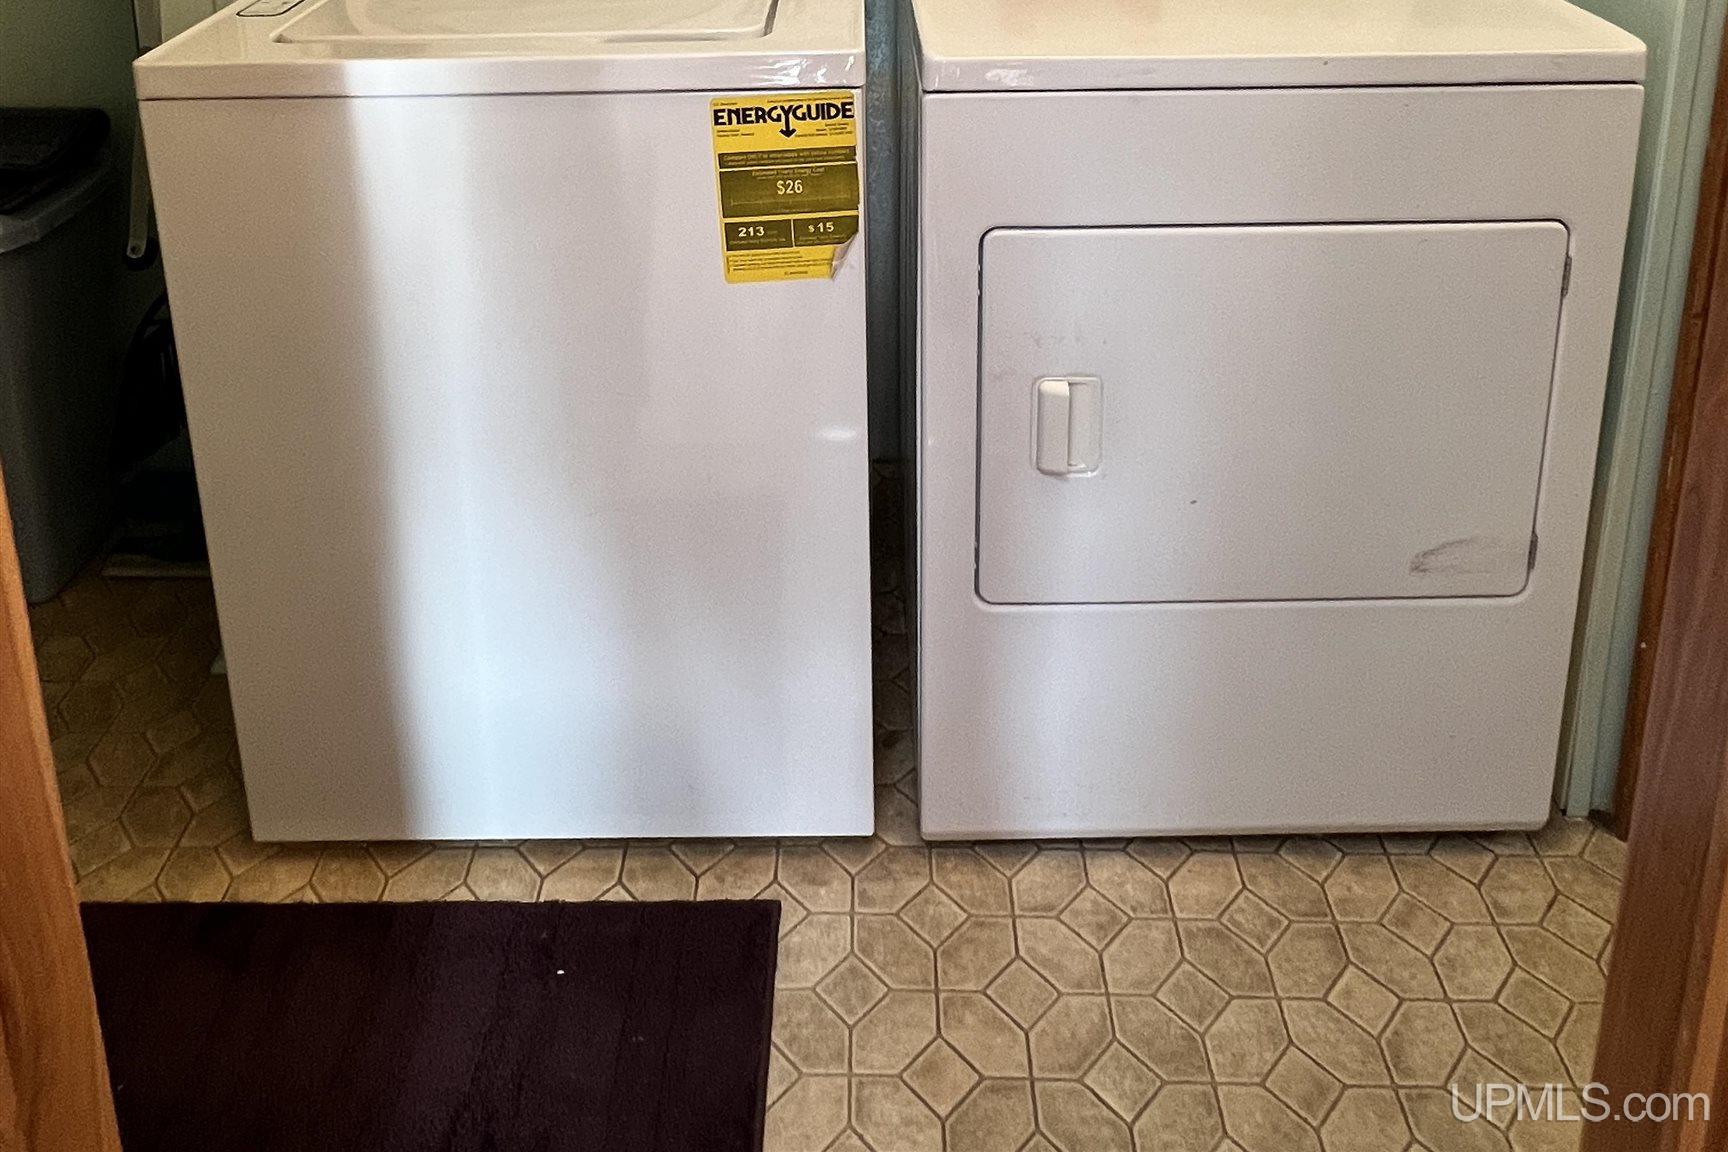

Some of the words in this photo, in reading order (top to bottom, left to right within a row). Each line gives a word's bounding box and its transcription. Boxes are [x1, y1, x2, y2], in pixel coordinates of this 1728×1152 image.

[713, 101, 854, 126] ENERGYGUIDE
[777, 180, 803, 194] $26
[738, 227, 764, 237] 213
